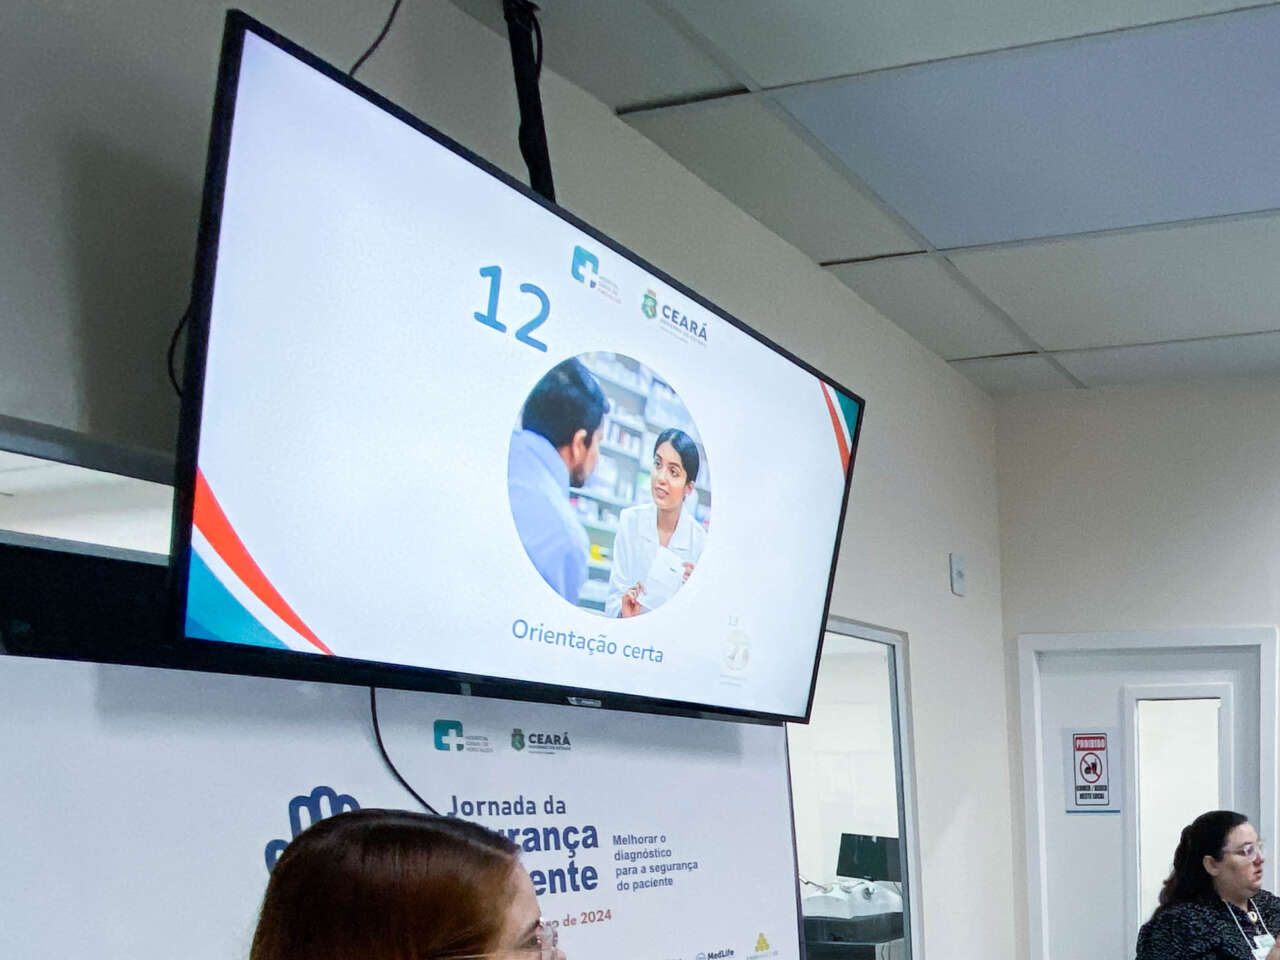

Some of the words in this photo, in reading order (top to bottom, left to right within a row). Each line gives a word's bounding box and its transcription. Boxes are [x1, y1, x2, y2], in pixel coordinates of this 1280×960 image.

[474, 265, 550, 352] 12
[661, 304, 708, 342] CEARÁ
[512, 618, 617, 656] Orientação
[622, 644, 664, 664] certa
[528, 732, 571, 746] CEARÁ
[448, 795, 537, 816] Jornada
[544, 795, 566, 814] da
[498, 825, 599, 858] rança
[613, 834, 658, 846] Melhorar
[660, 834, 667, 844] o
[614, 848, 672, 862] diagnóstico
[529, 860, 599, 896] ente
[616, 865, 639, 878] para
[640, 865, 647, 874] a
[650, 860, 698, 874] segurança
[616, 880, 630, 891] do
[632, 875, 673, 892] paciente
[563, 913, 577, 927] de
[581, 909, 612, 924] 2024
